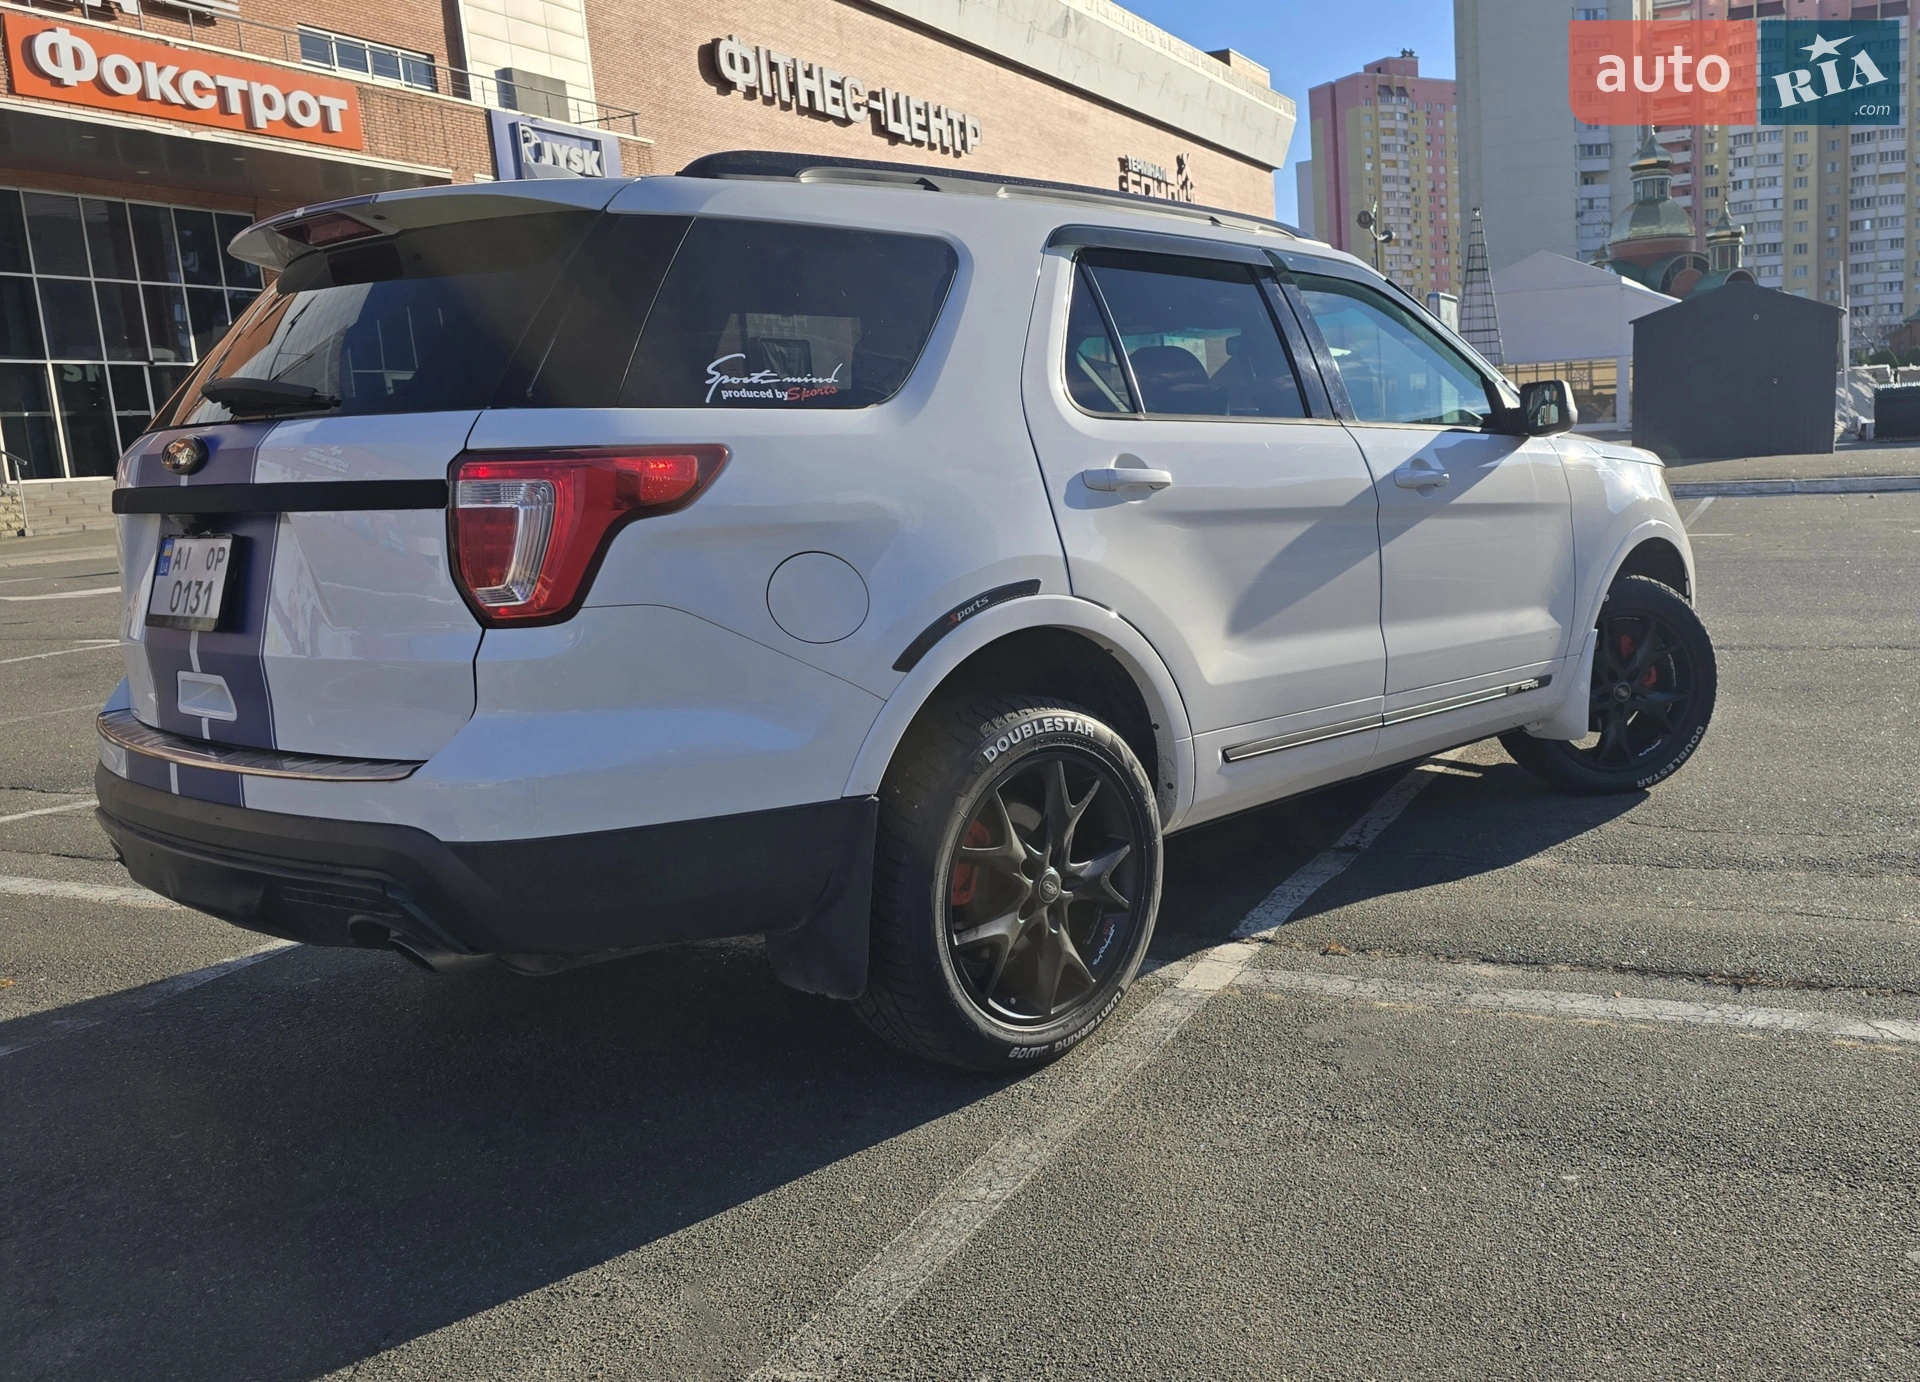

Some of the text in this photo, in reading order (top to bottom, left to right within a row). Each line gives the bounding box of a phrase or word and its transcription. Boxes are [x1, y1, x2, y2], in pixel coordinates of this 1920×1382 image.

[33, 27, 348, 133] Фокстрот
[717, 34, 982, 154] ФІТНЕС-ЦЕНТР
[538, 141, 602, 176] JYSK
[721, 385, 838, 401] produced by Sports
[172, 546, 226, 571] AI OP
[169, 580, 214, 615] 0131
[982, 717, 1095, 763] DOUBLESTAR
[1636, 725, 1704, 788] DOUBLESTAR
[1054, 990, 1122, 1053] WINTERKING
